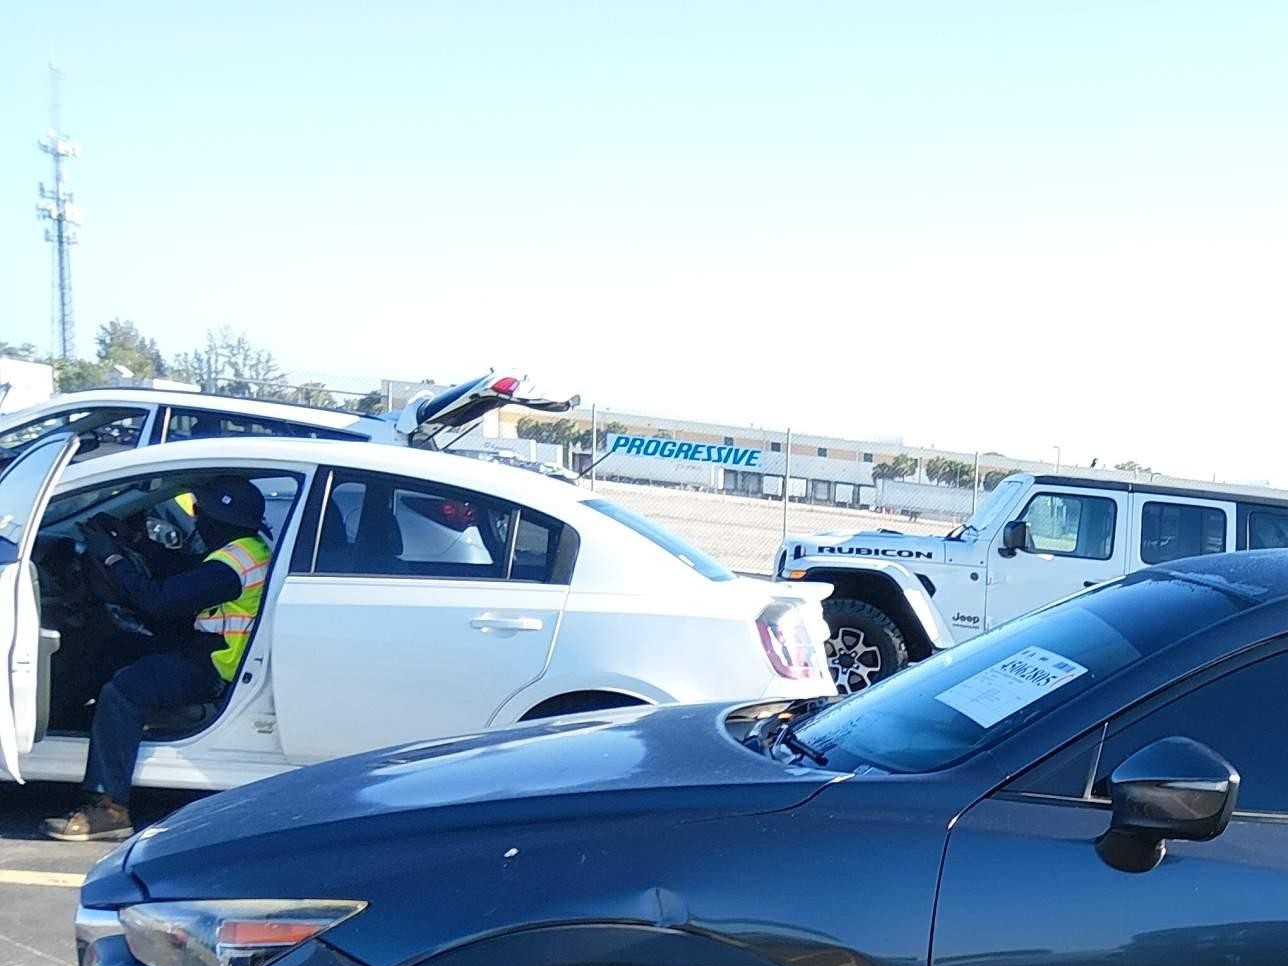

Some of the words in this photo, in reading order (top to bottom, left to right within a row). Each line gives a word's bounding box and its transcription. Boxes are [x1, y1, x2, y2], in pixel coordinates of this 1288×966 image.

[612, 435, 762, 467] PROGRESSIVE
[817, 545, 933, 560] RUBICON
[952, 612, 980, 625] Jeep
[1000, 660, 1057, 687] 45062805
